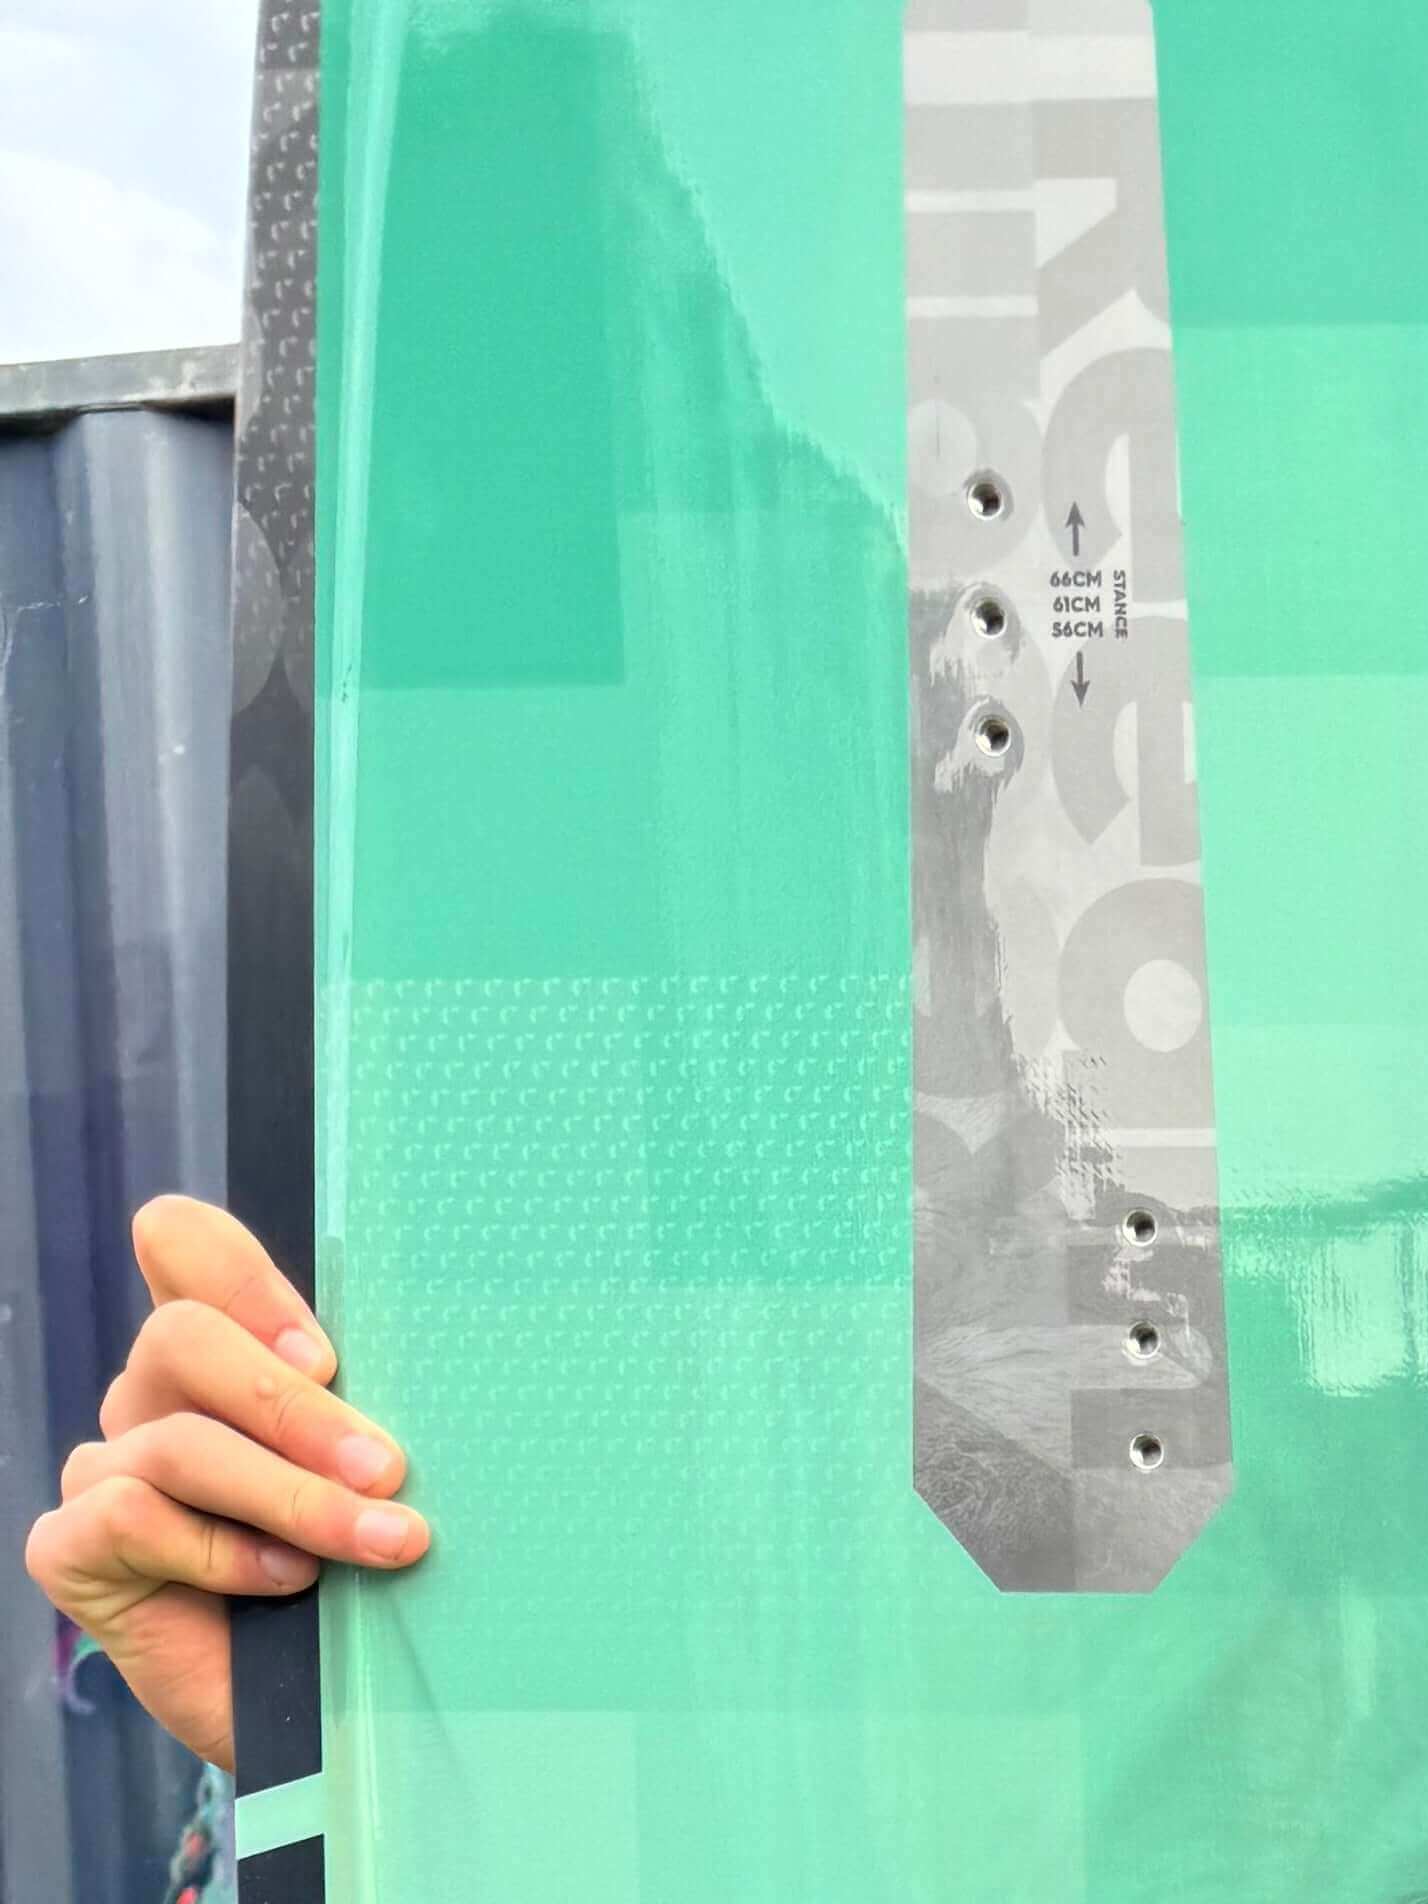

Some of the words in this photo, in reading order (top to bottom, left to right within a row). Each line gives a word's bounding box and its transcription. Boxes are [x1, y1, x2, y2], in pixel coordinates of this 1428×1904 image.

[1050, 570, 1102, 588] 66CM
[1053, 596, 1101, 612] 61CM
[1113, 570, 1128, 639] STANCE
[1051, 621, 1103, 638] 56CM
